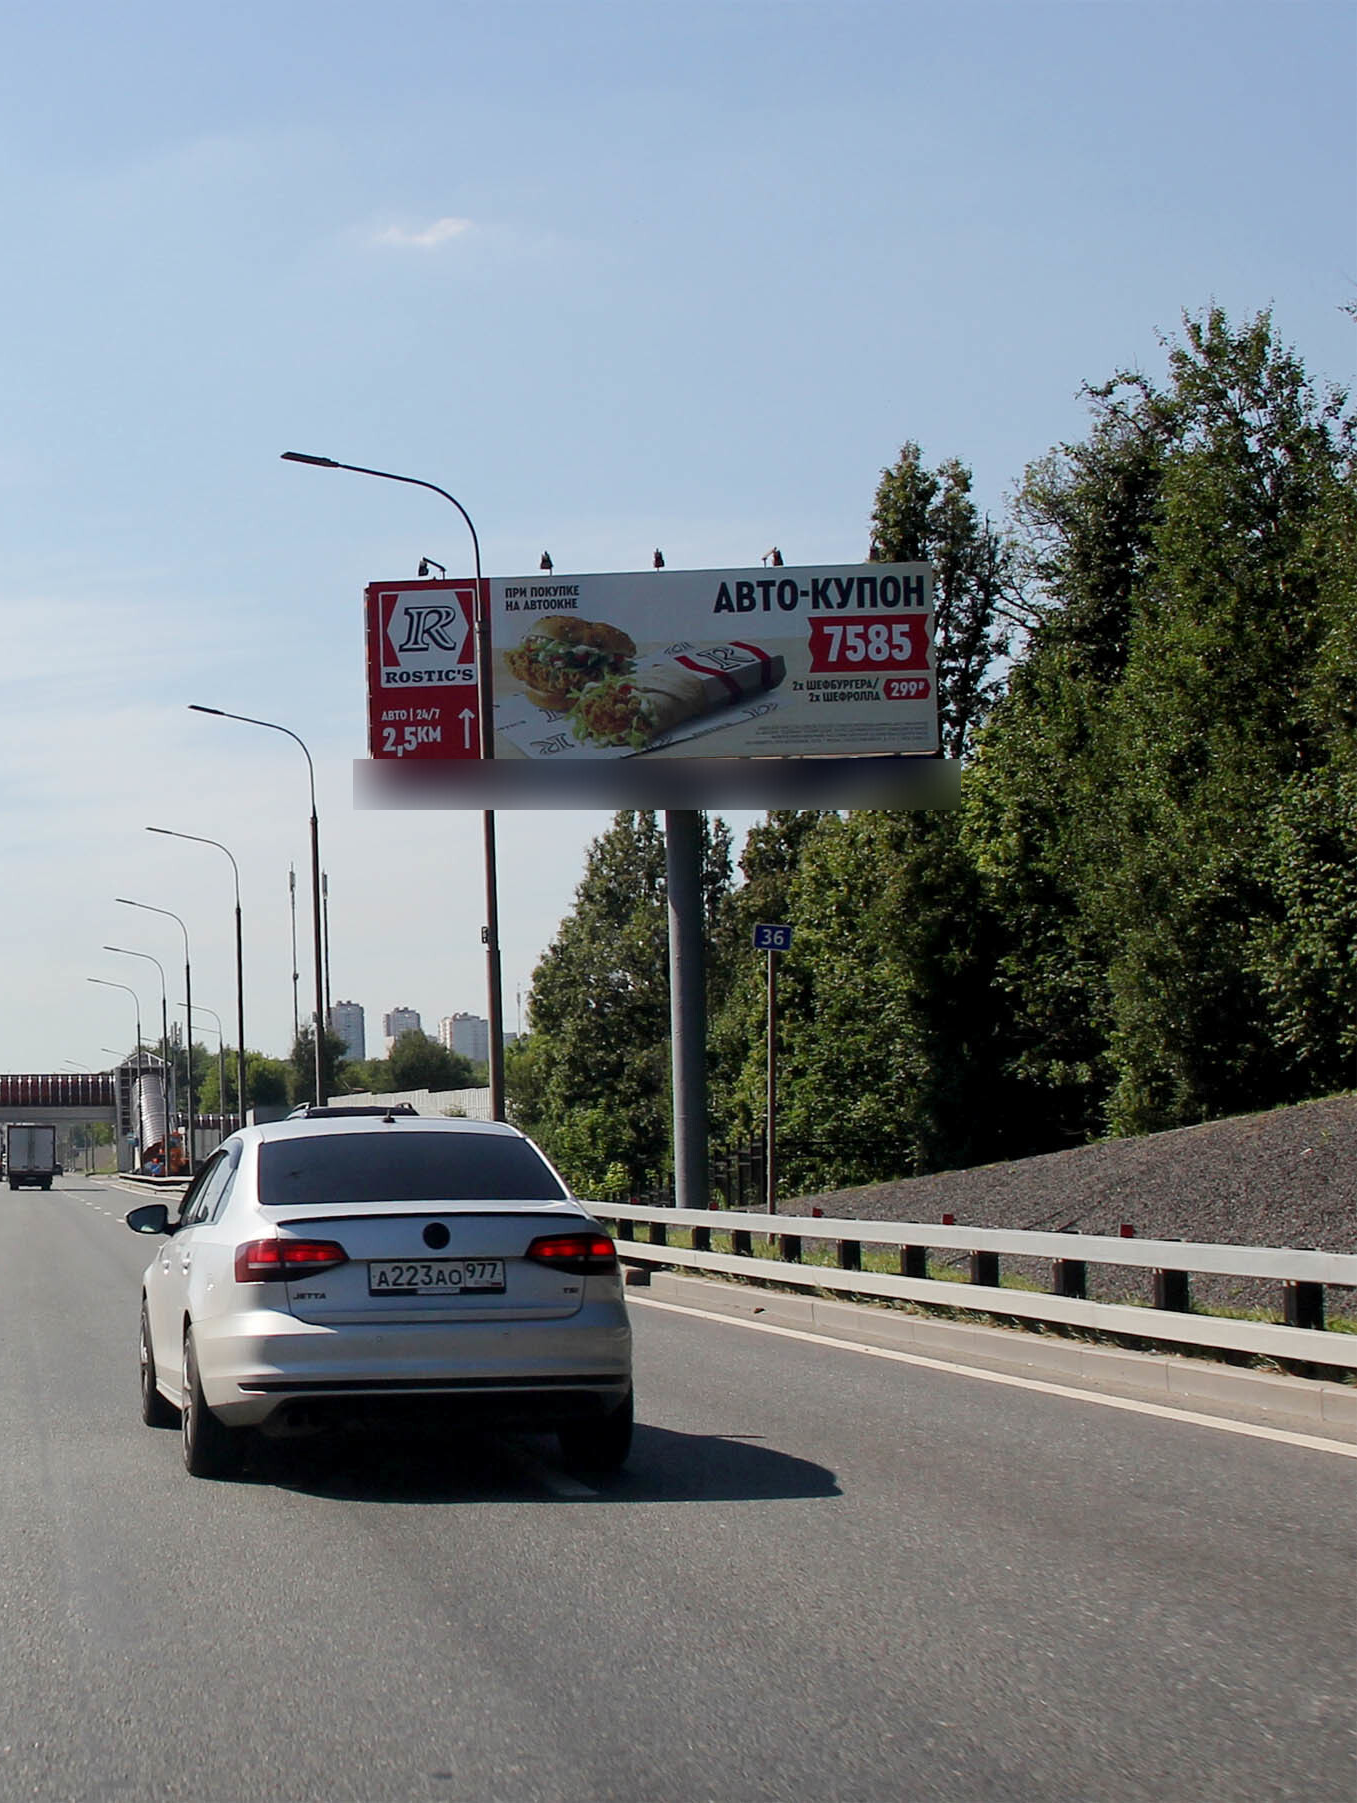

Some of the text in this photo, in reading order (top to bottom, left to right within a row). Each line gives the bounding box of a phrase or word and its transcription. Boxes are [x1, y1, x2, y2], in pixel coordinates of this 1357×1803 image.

[505, 585, 580, 598] ПРИ ПОКУПКЕ
[713, 575, 925, 613] АВТО-КУПОН
[505, 598, 579, 611] НА АВТООКНЕ
[398, 606, 457, 652] R
[823, 624, 912, 662] 7585
[385, 668, 474, 684] ROSTIC'S
[806, 677, 880, 690] ШЕФБУРГЕРА/
[822, 690, 881, 702] ШЕФРОЛЛА
[381, 707, 440, 721] АВТО 24/7
[761, 929, 784, 946] 36
[467, 1262, 498, 1279] 977
[293, 1292, 326, 1300] JETTA
